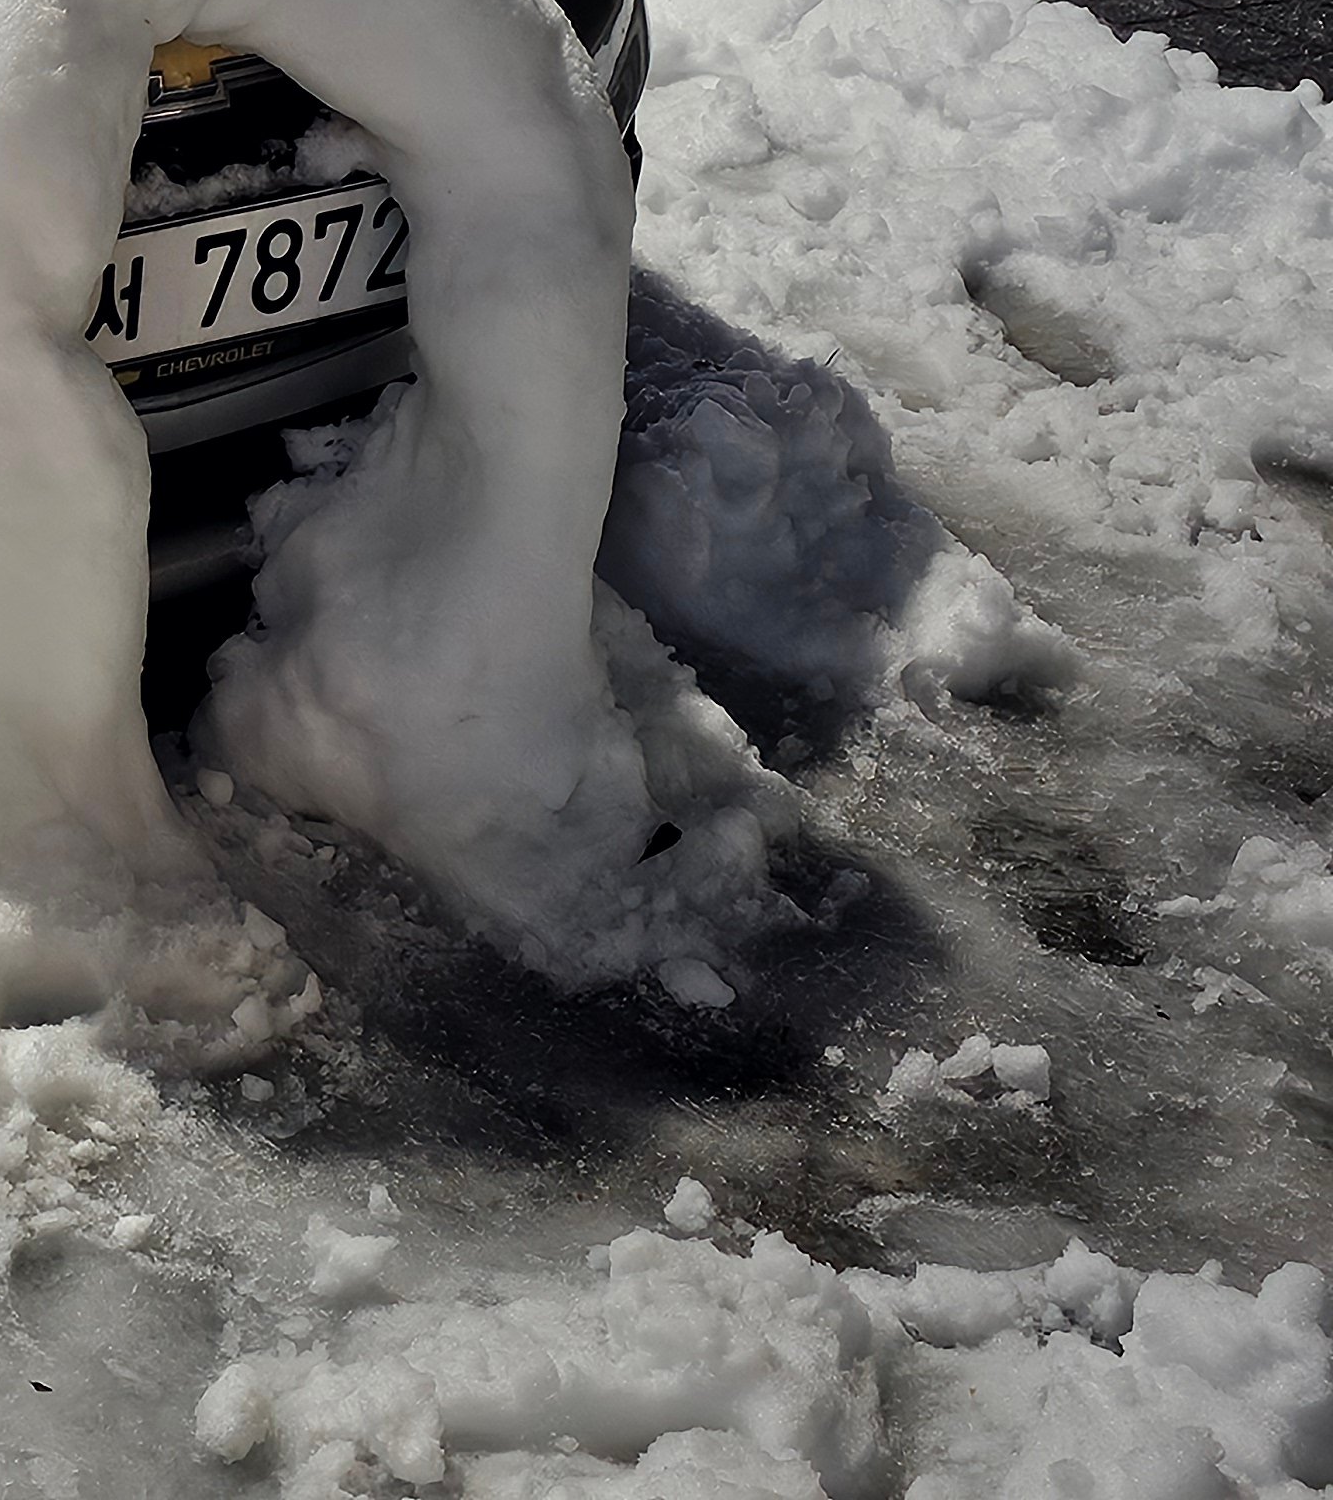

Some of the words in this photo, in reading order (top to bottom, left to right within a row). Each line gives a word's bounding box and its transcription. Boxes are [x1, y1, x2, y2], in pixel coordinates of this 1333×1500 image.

[83, 253, 145, 342] 서
[194, 196, 410, 329] 7872
[156, 339, 275, 378] CHEVROLET
